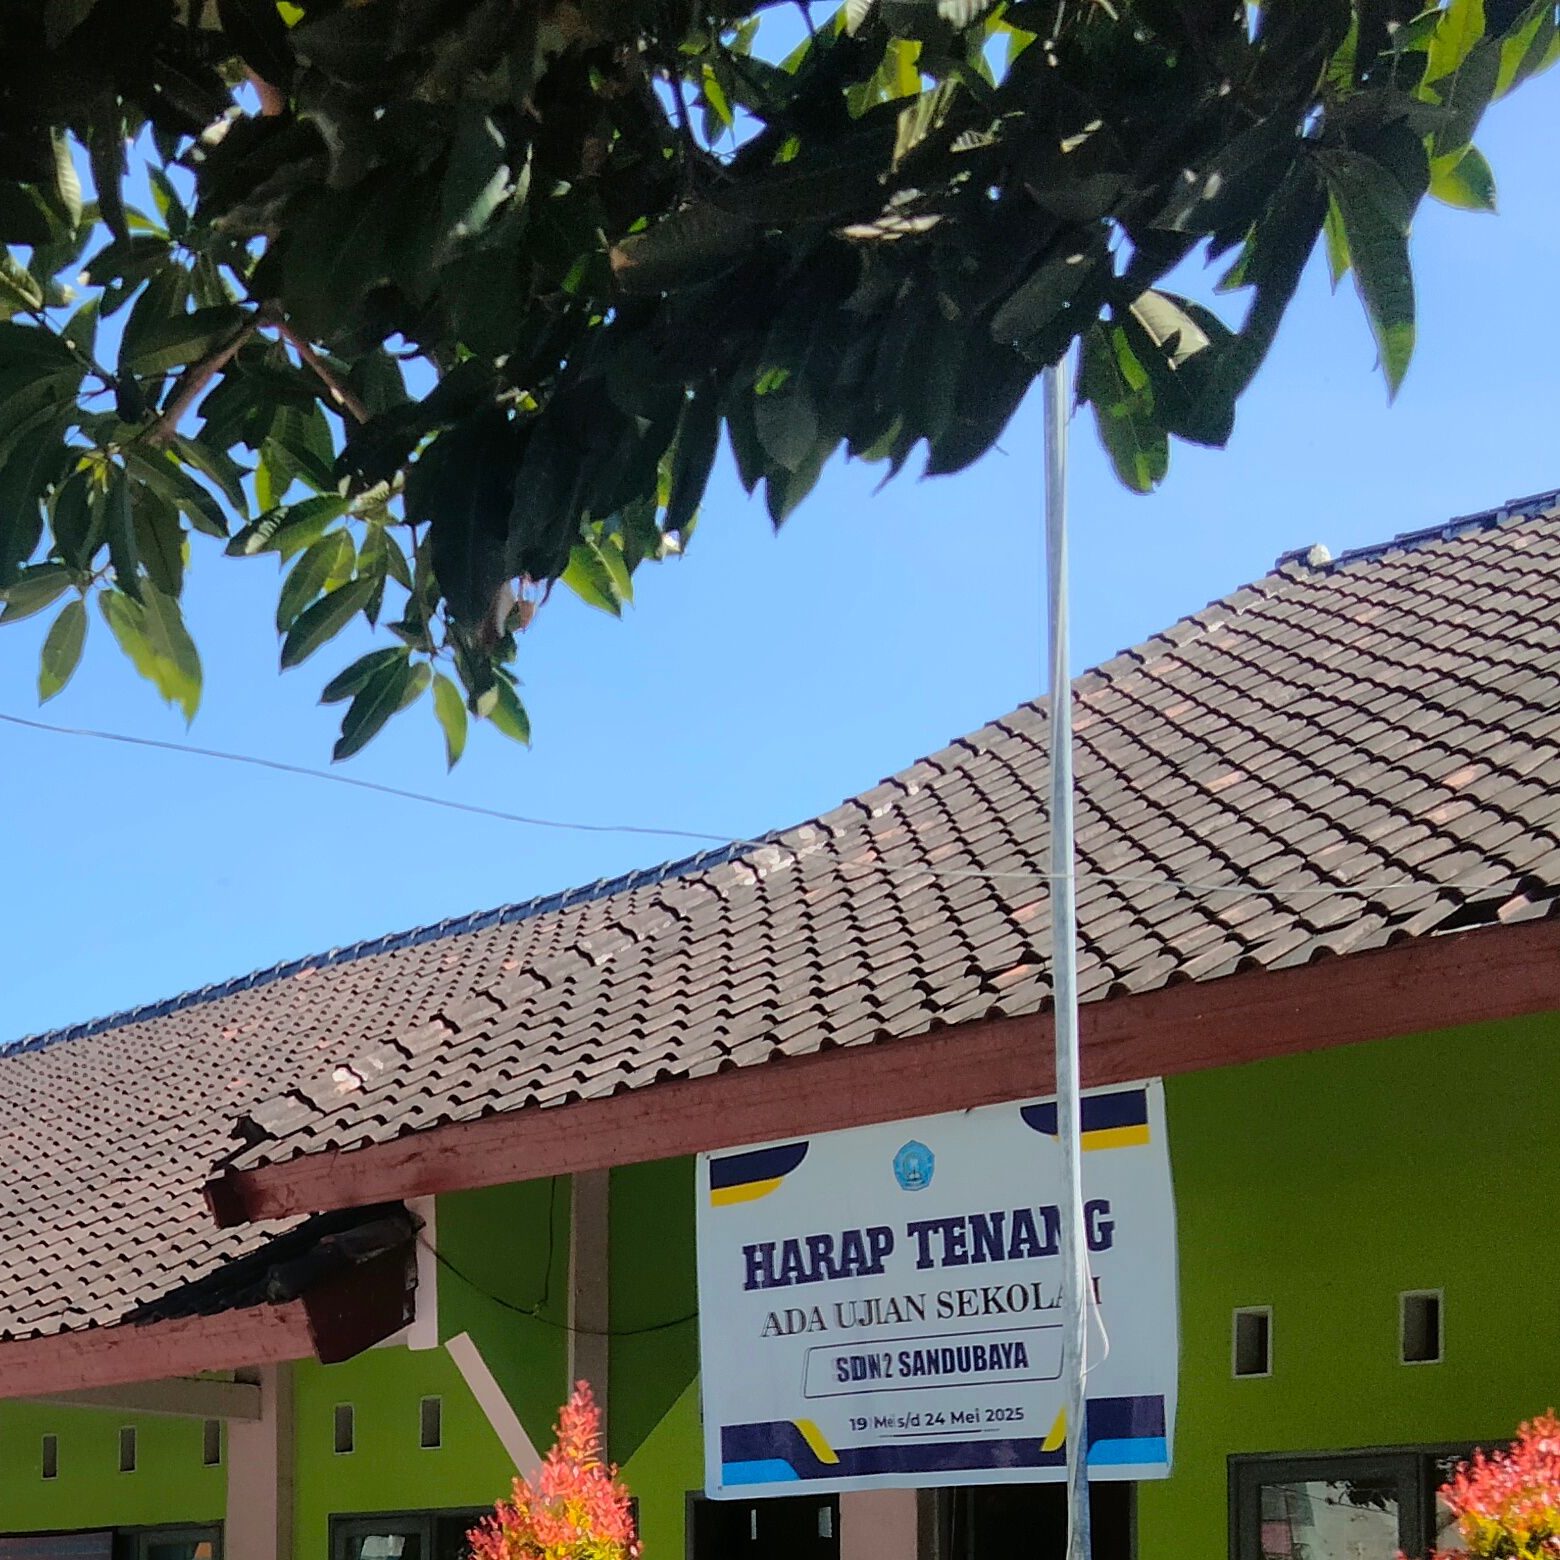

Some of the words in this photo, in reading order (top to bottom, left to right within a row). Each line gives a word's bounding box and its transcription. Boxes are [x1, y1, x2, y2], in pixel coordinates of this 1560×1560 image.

[742, 1225, 895, 1291] HARAP
[760, 1305, 828, 1337] ADA
[834, 1293, 927, 1329] UJIAN
[936, 1276, 1102, 1320] SEKOL
[898, 1341, 1030, 1378] SANDUBAYA
[849, 1416, 868, 1431] 19
[898, 1411, 920, 1429] s/d
[924, 1411, 946, 1426] 24
[950, 1407, 981, 1425] Mei
[984, 1406, 1025, 1422] 2025
